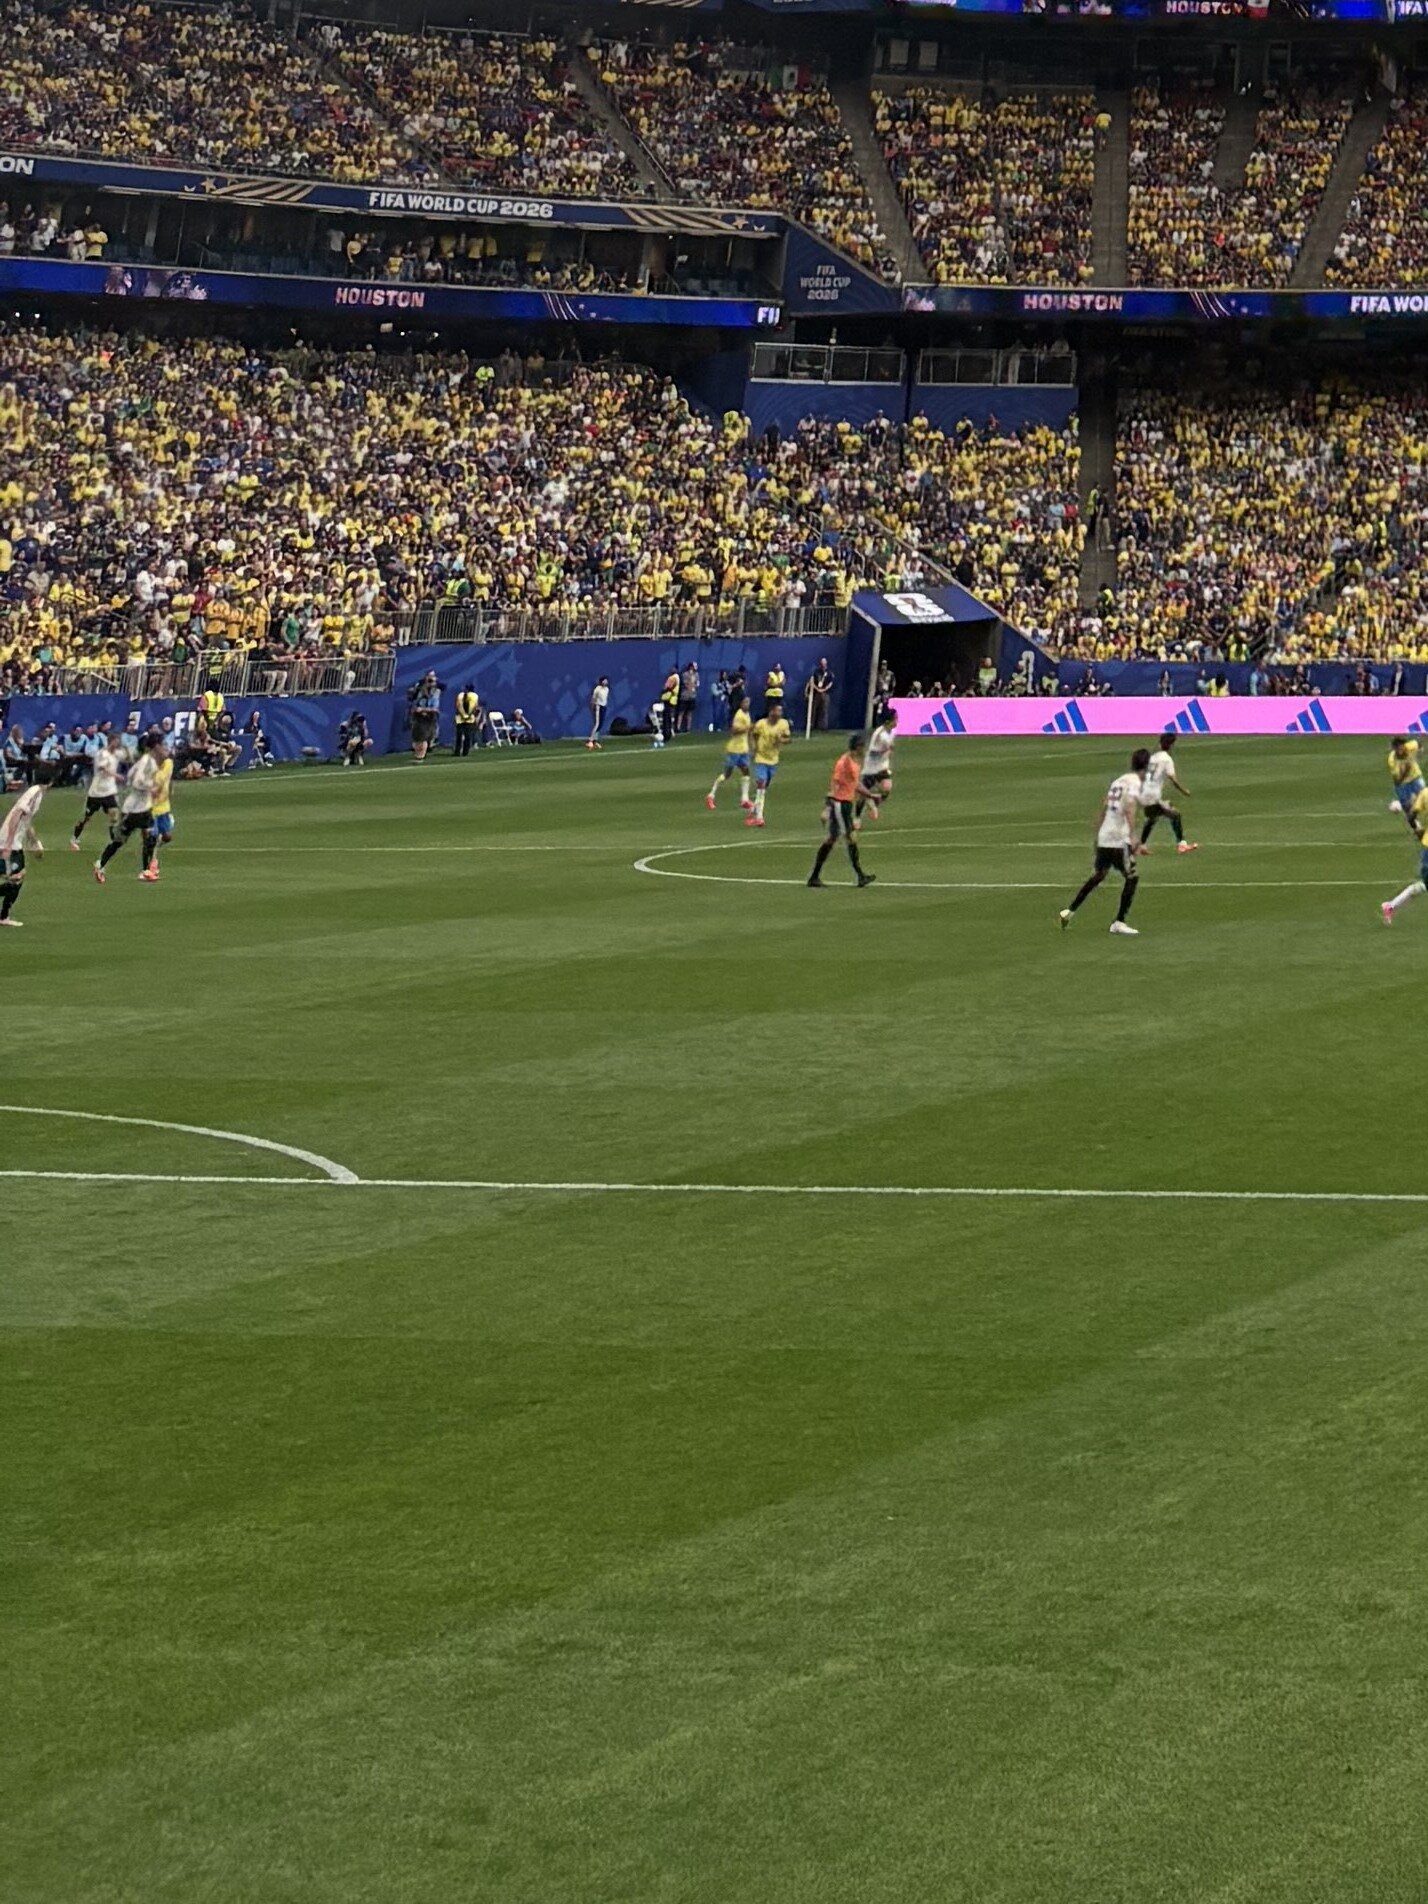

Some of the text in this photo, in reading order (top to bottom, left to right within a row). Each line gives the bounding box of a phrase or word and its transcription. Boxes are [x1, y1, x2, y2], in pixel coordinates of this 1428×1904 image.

[1399, 1, 1424, 16] IFA
[369, 192, 554, 219] FIFA WORLD CUP 2026
[334, 286, 425, 308] HOUSTON
[1023, 293, 1123, 311] HOUSTON
[1350, 294, 1392, 313] FIFA
